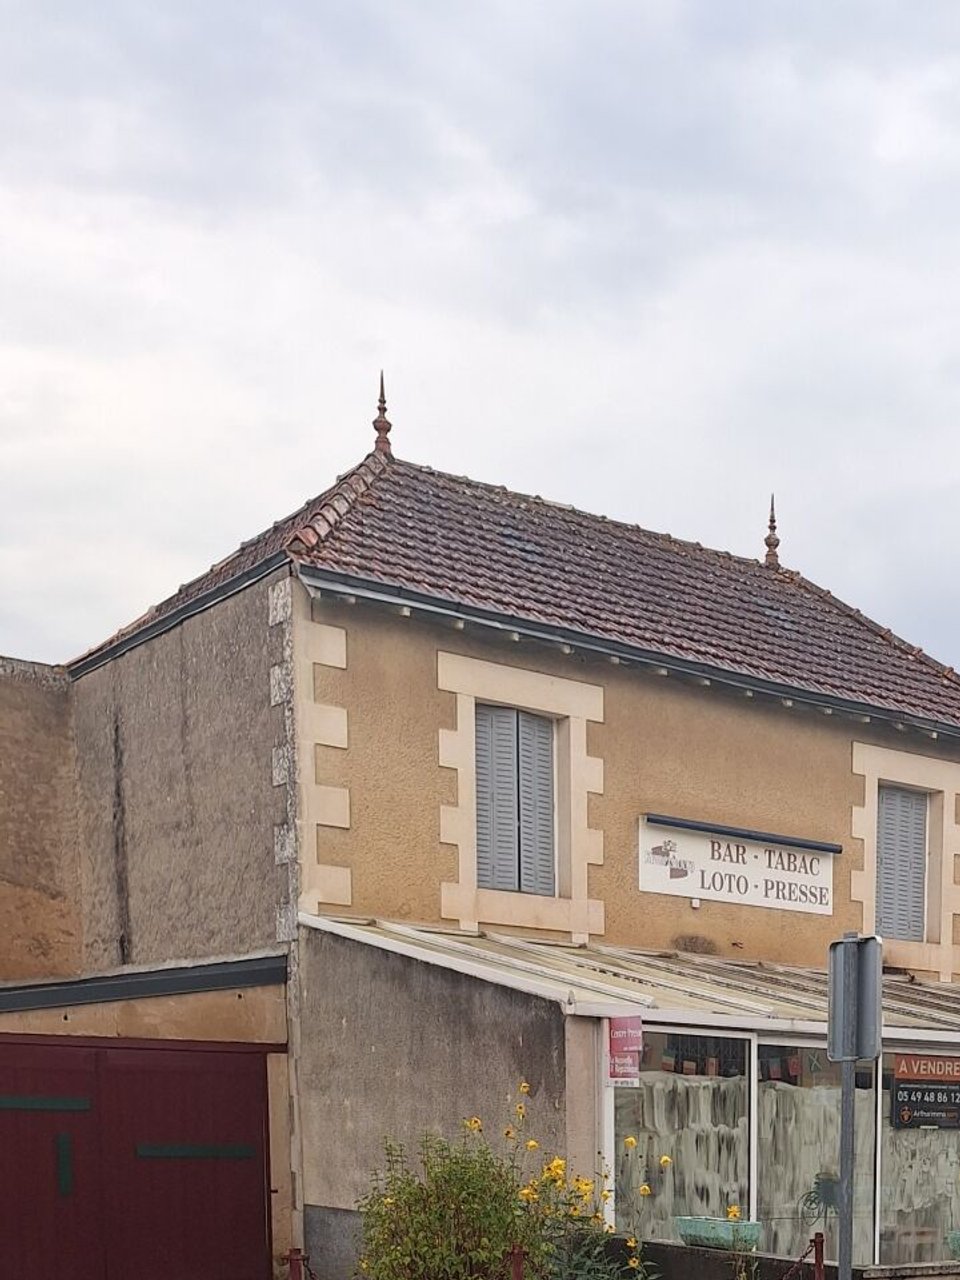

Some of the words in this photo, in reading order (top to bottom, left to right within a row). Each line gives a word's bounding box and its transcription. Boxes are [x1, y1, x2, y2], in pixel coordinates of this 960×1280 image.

[710, 840, 747, 865] BAR
[764, 849, 820, 876] TABAC
[700, 869, 749, 895] LOTO
[763, 879, 829, 906] PRESSE
[898, 1059, 908, 1073] A
[911, 1060, 960, 1076] VENDRE
[897, 1090, 909, 1102] 05
[910, 1091, 922, 1103] 49
[924, 1092, 935, 1103] 48
[937, 1092, 948, 1103] 86
[950, 1093, 960, 1104] 12
